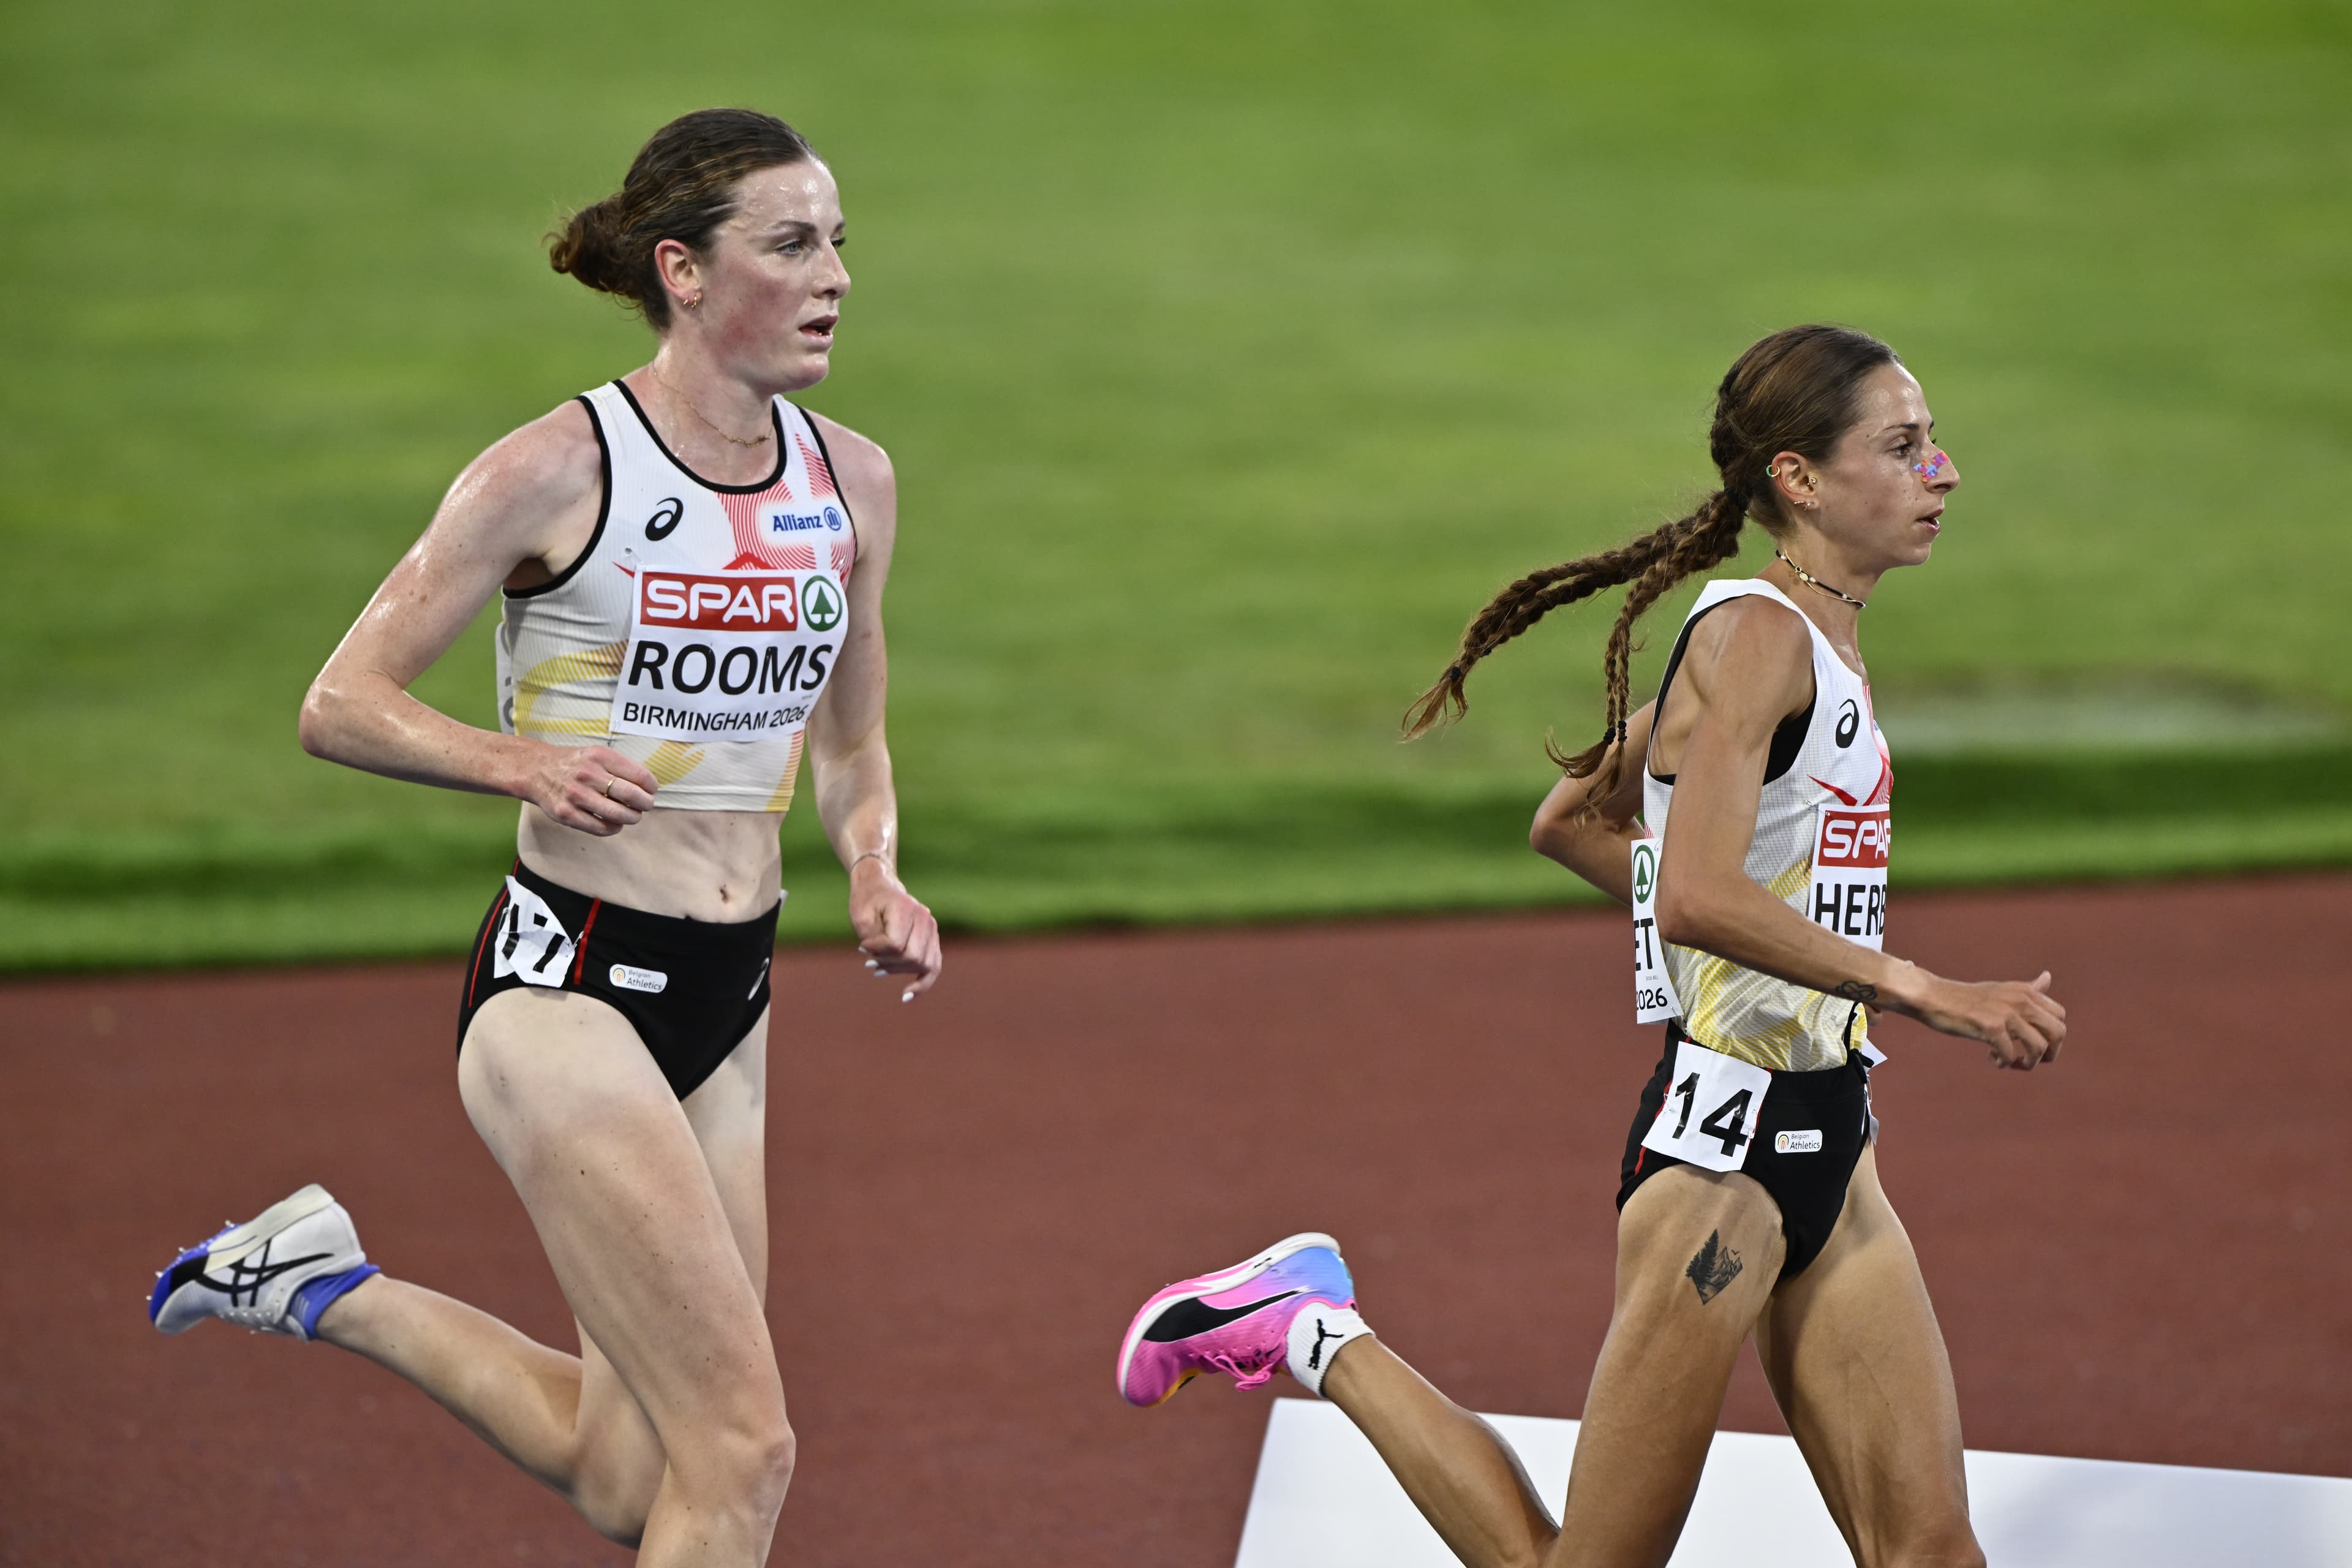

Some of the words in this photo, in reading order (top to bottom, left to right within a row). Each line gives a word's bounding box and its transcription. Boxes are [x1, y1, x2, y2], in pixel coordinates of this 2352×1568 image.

[773, 514, 823, 532] Allianz
[646, 579, 795, 624] SPAR
[628, 640, 833, 695] ROOMS
[623, 702, 768, 731] BIRMINGHAM
[769, 704, 809, 728] 2026
[627, 978, 663, 990] Athletics
[628, 970, 651, 978] Belgian
[1672, 1072, 1753, 1157] 14
[1790, 1140, 1820, 1150] Athletics
